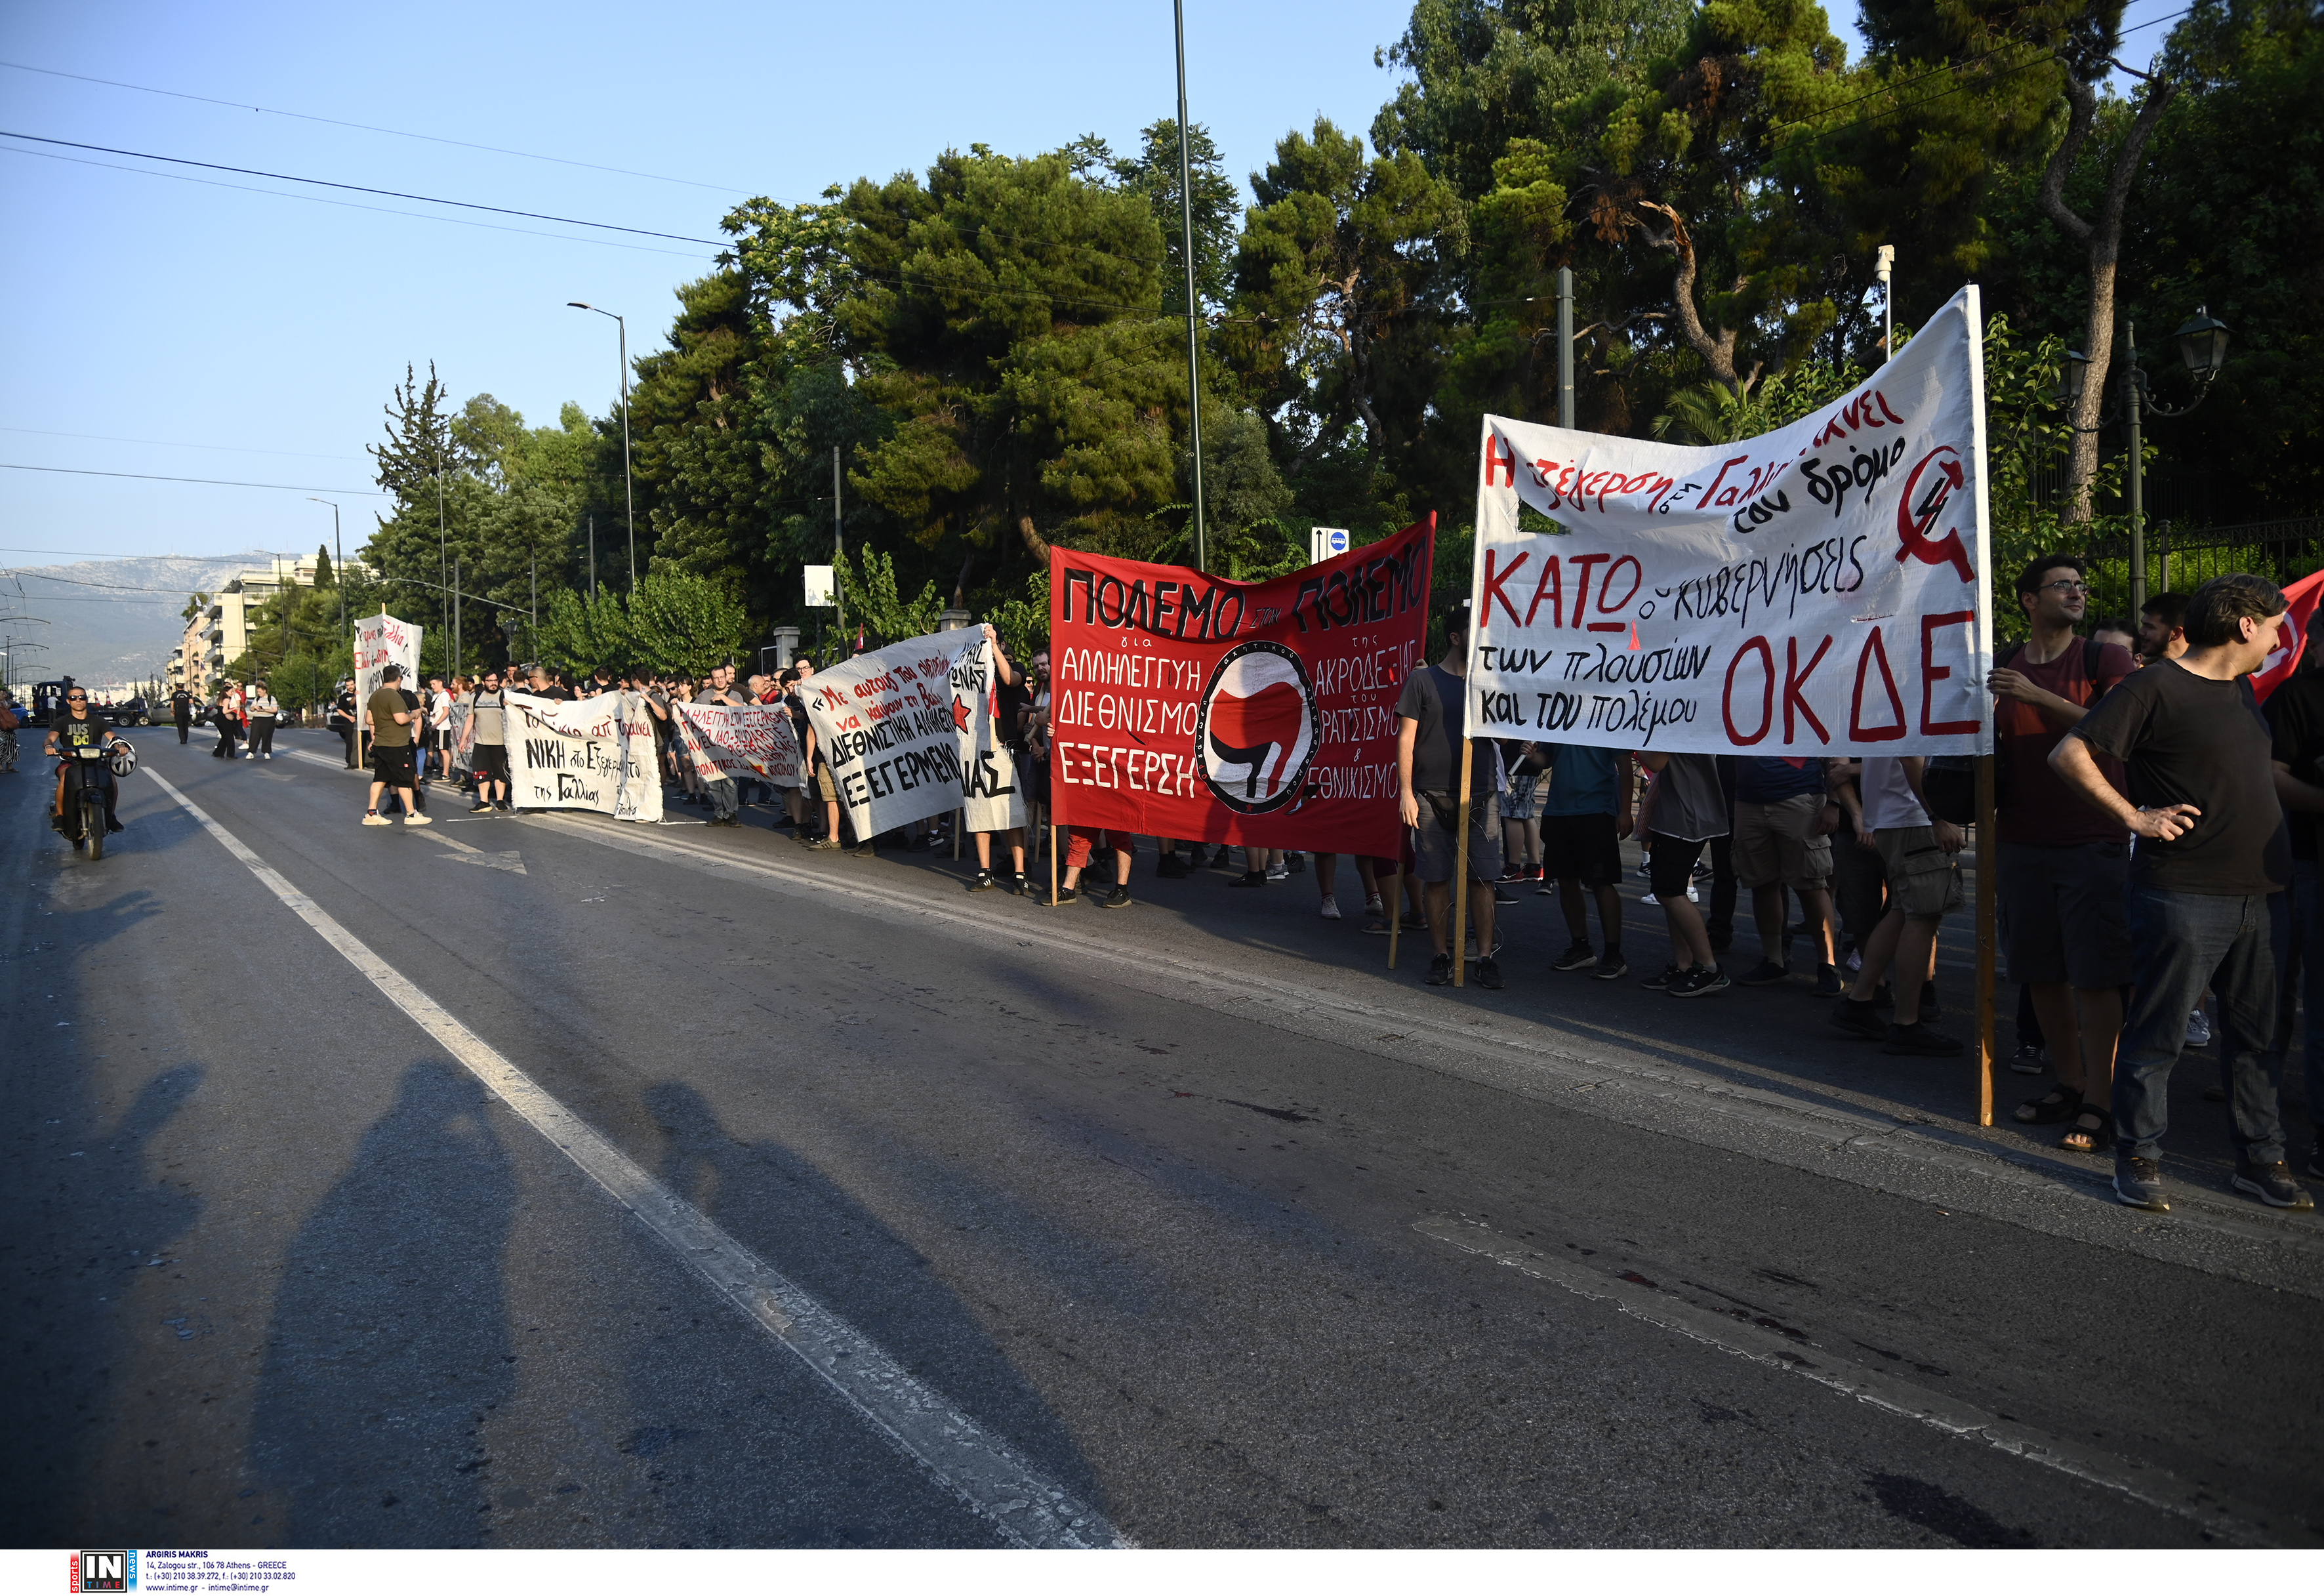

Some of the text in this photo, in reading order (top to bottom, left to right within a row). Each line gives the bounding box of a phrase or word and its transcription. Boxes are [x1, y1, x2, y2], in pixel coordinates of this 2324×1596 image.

[1485, 433, 1516, 489] Η
[1799, 436, 1906, 519] δρόμο
[1063, 566, 1246, 640] ΠΟΛΕΜΟ
[1291, 535, 1427, 634] ΠΟΛΕΜΟ
[1120, 636, 1152, 648] για
[1352, 634, 1377, 649] της
[1061, 646, 1201, 692] ΑΛΛΗΛΕΓΓΥΗ
[1721, 609, 1982, 747] ΟΚΔΕ
[67, 723, 89, 735] JUS
[835, 714, 862, 733] να
[1059, 689, 1200, 736] ΔΙΕΘΝΙΣΜΟ
[1321, 701, 1399, 744] ΡΑΤΣΙΣΜΟ
[525, 738, 565, 769] ΝΙΚΗ
[1059, 741, 1196, 799] ΕΞΕΓΕΡΣΗ
[1307, 761, 1399, 800] ΕΘΝΙΚΙΣΜΟ
